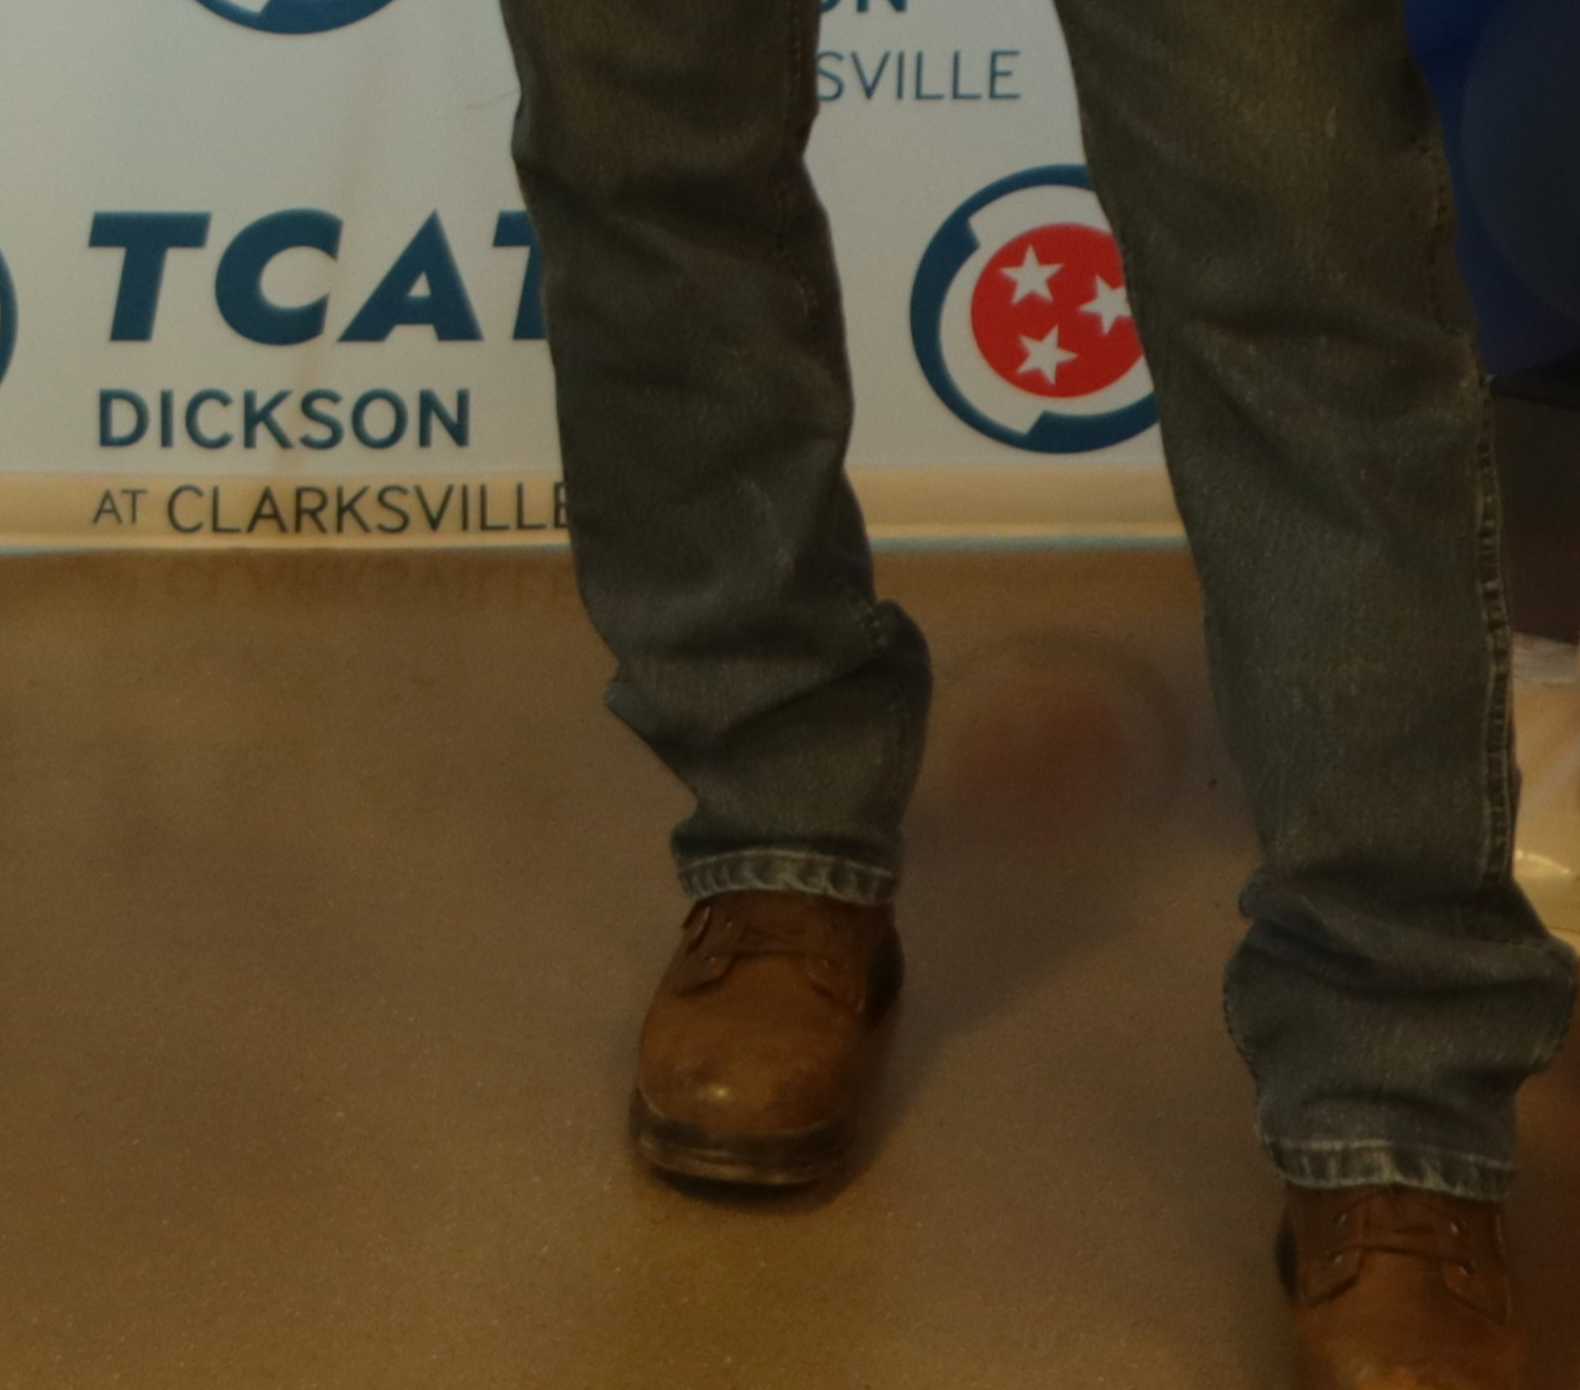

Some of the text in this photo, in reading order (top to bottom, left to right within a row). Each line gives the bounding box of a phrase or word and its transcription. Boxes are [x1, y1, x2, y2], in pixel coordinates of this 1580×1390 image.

[816, 49, 1022, 102] SVILLE
[98, 387, 471, 450] DICKSON
[92, 488, 149, 525] AT
